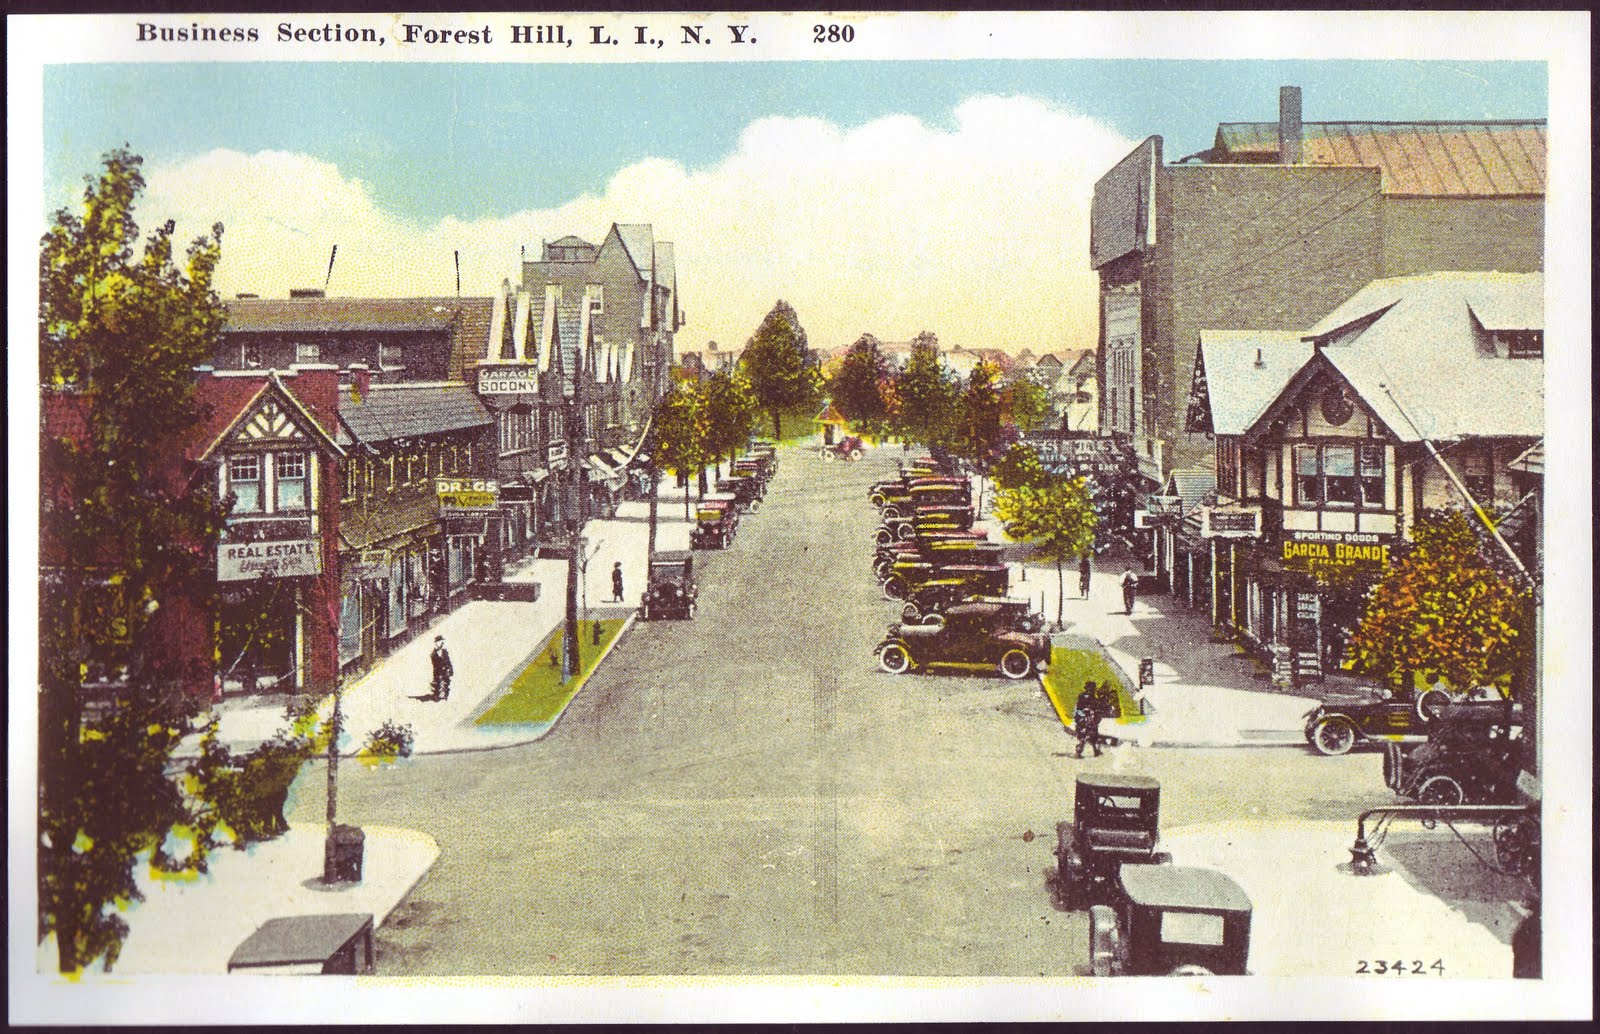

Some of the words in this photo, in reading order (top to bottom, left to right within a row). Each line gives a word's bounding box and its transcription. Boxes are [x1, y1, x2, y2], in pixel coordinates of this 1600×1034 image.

[480, 381, 536, 392] SOCONY
[227, 547, 263, 560] REAL
[266, 543, 314, 558] ESTATE
[1283, 540, 1329, 559] GARCIA
[1335, 543, 1390, 564] GRANDE
